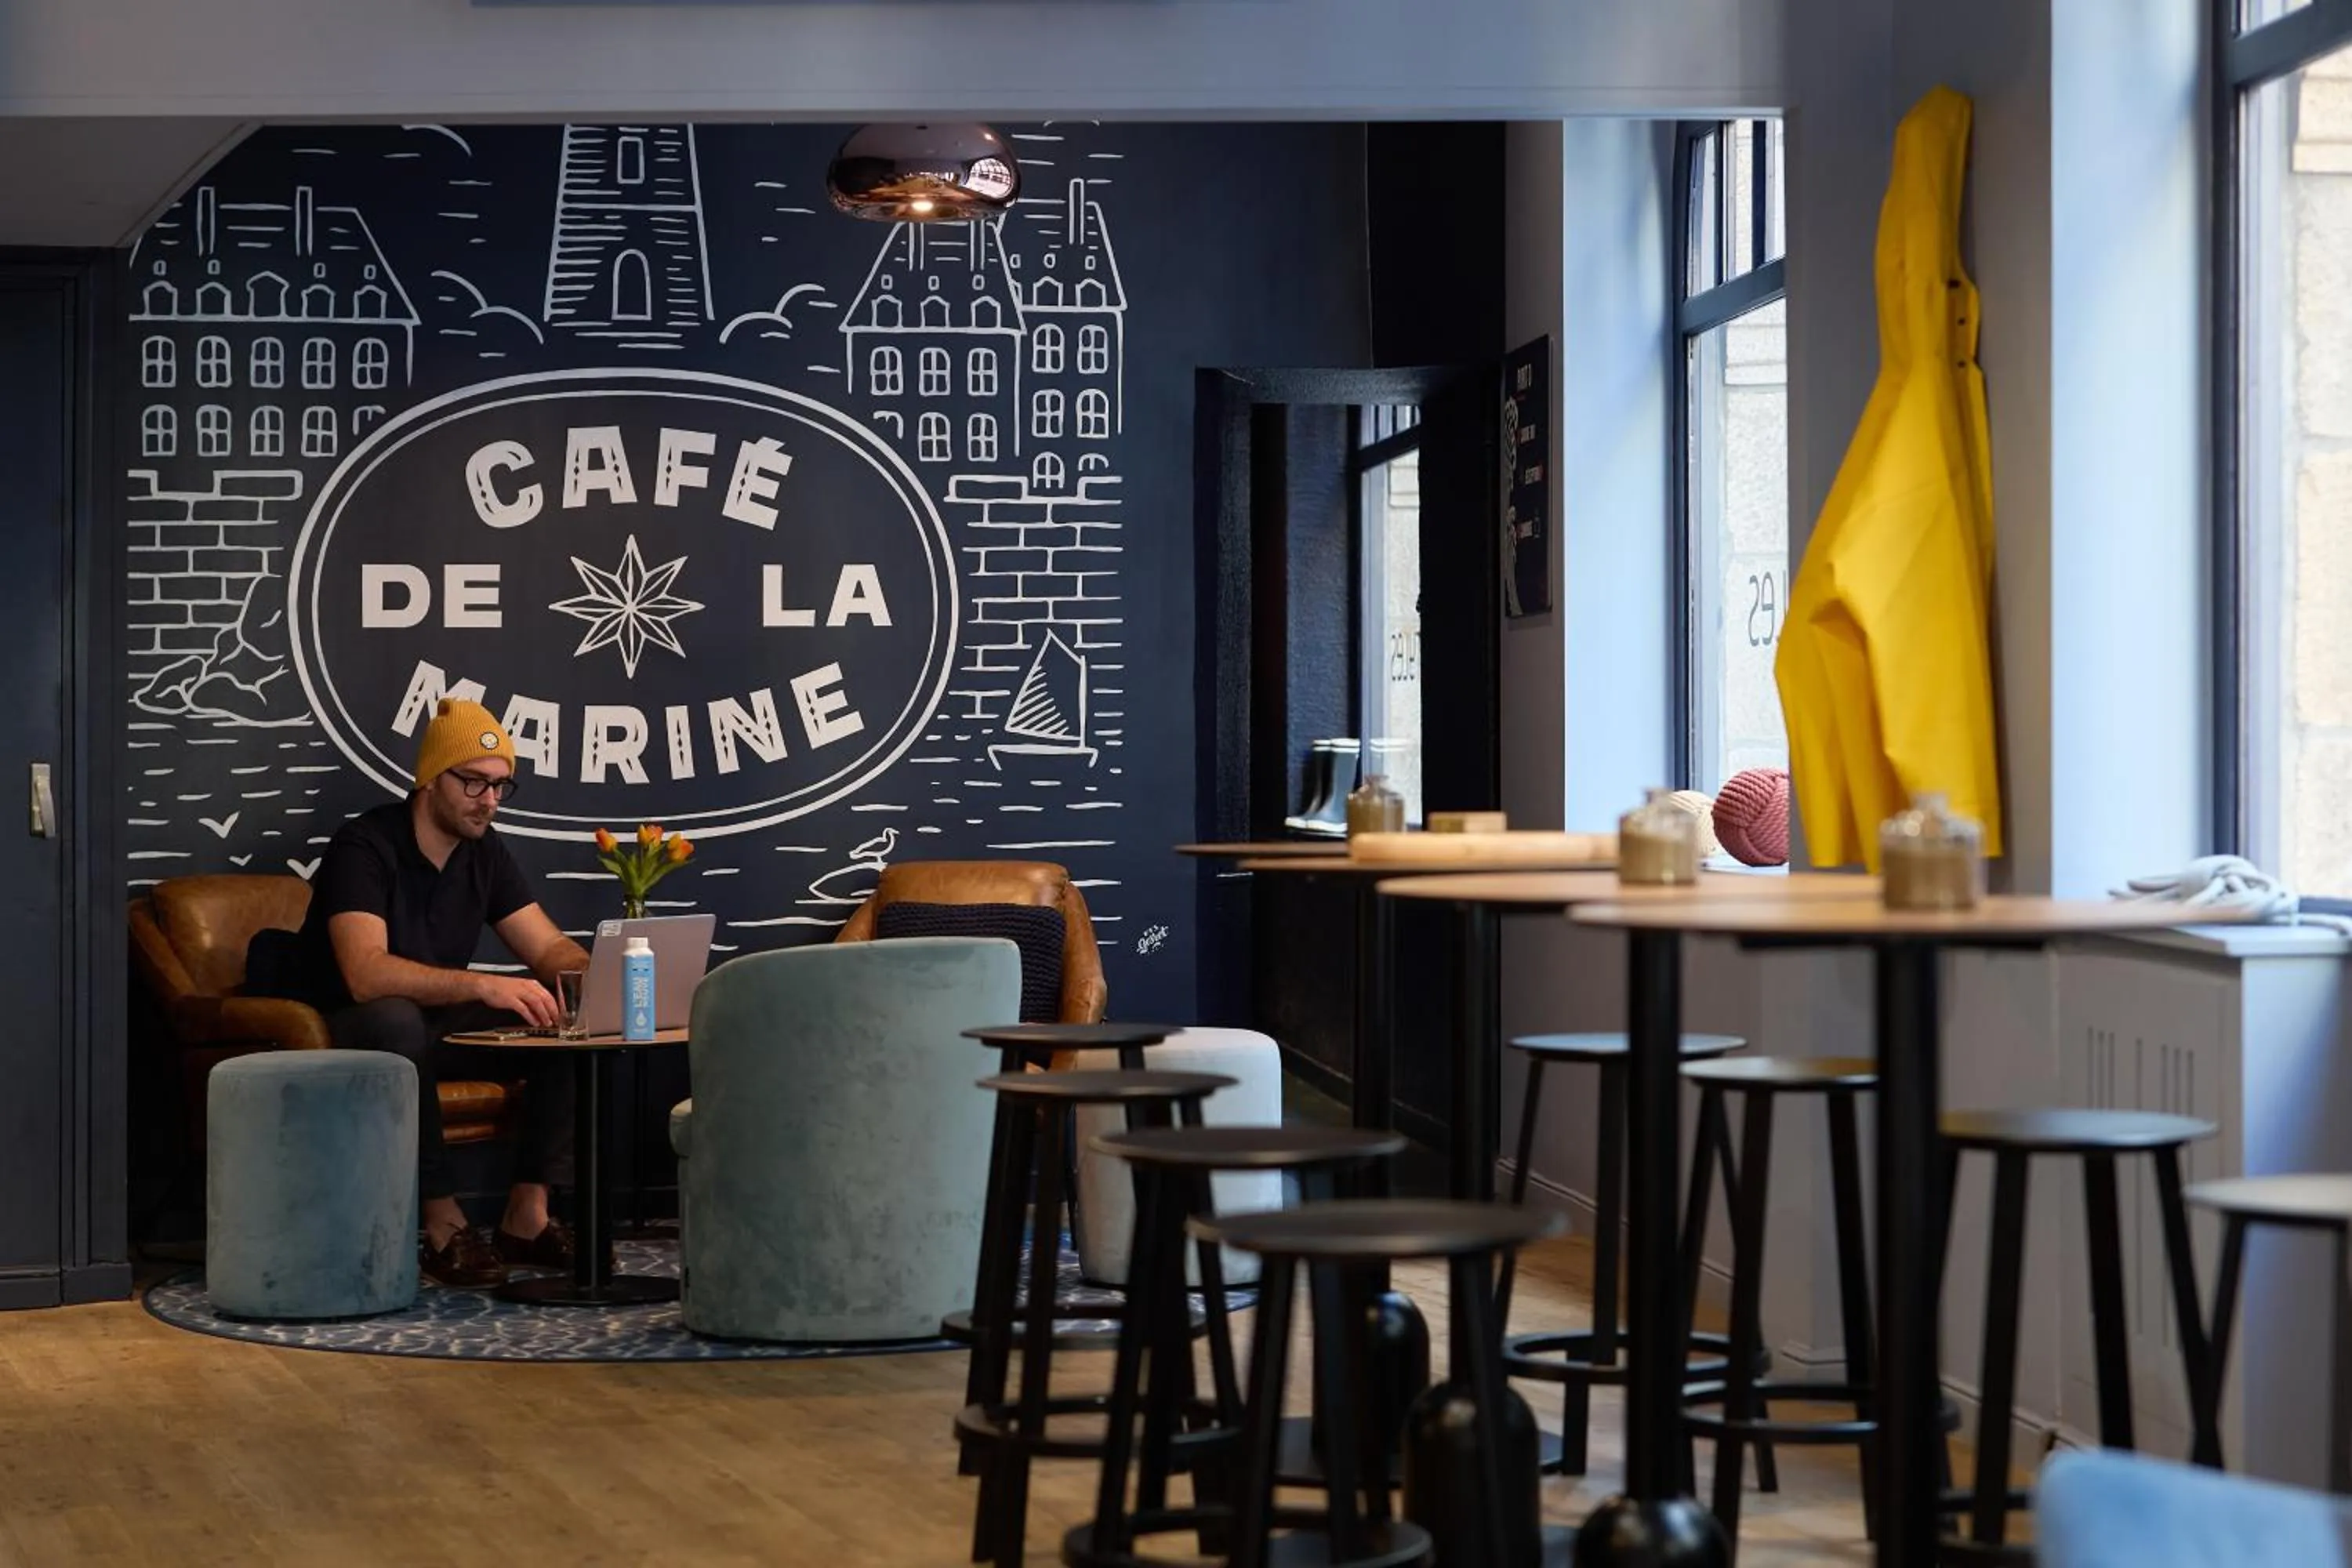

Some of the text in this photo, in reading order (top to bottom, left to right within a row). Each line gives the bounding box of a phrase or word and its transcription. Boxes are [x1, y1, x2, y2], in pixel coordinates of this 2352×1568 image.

[466, 426, 793, 531] CAFÉ
[361, 564, 892, 628] DE LA
[391, 659, 865, 784] MARINE
